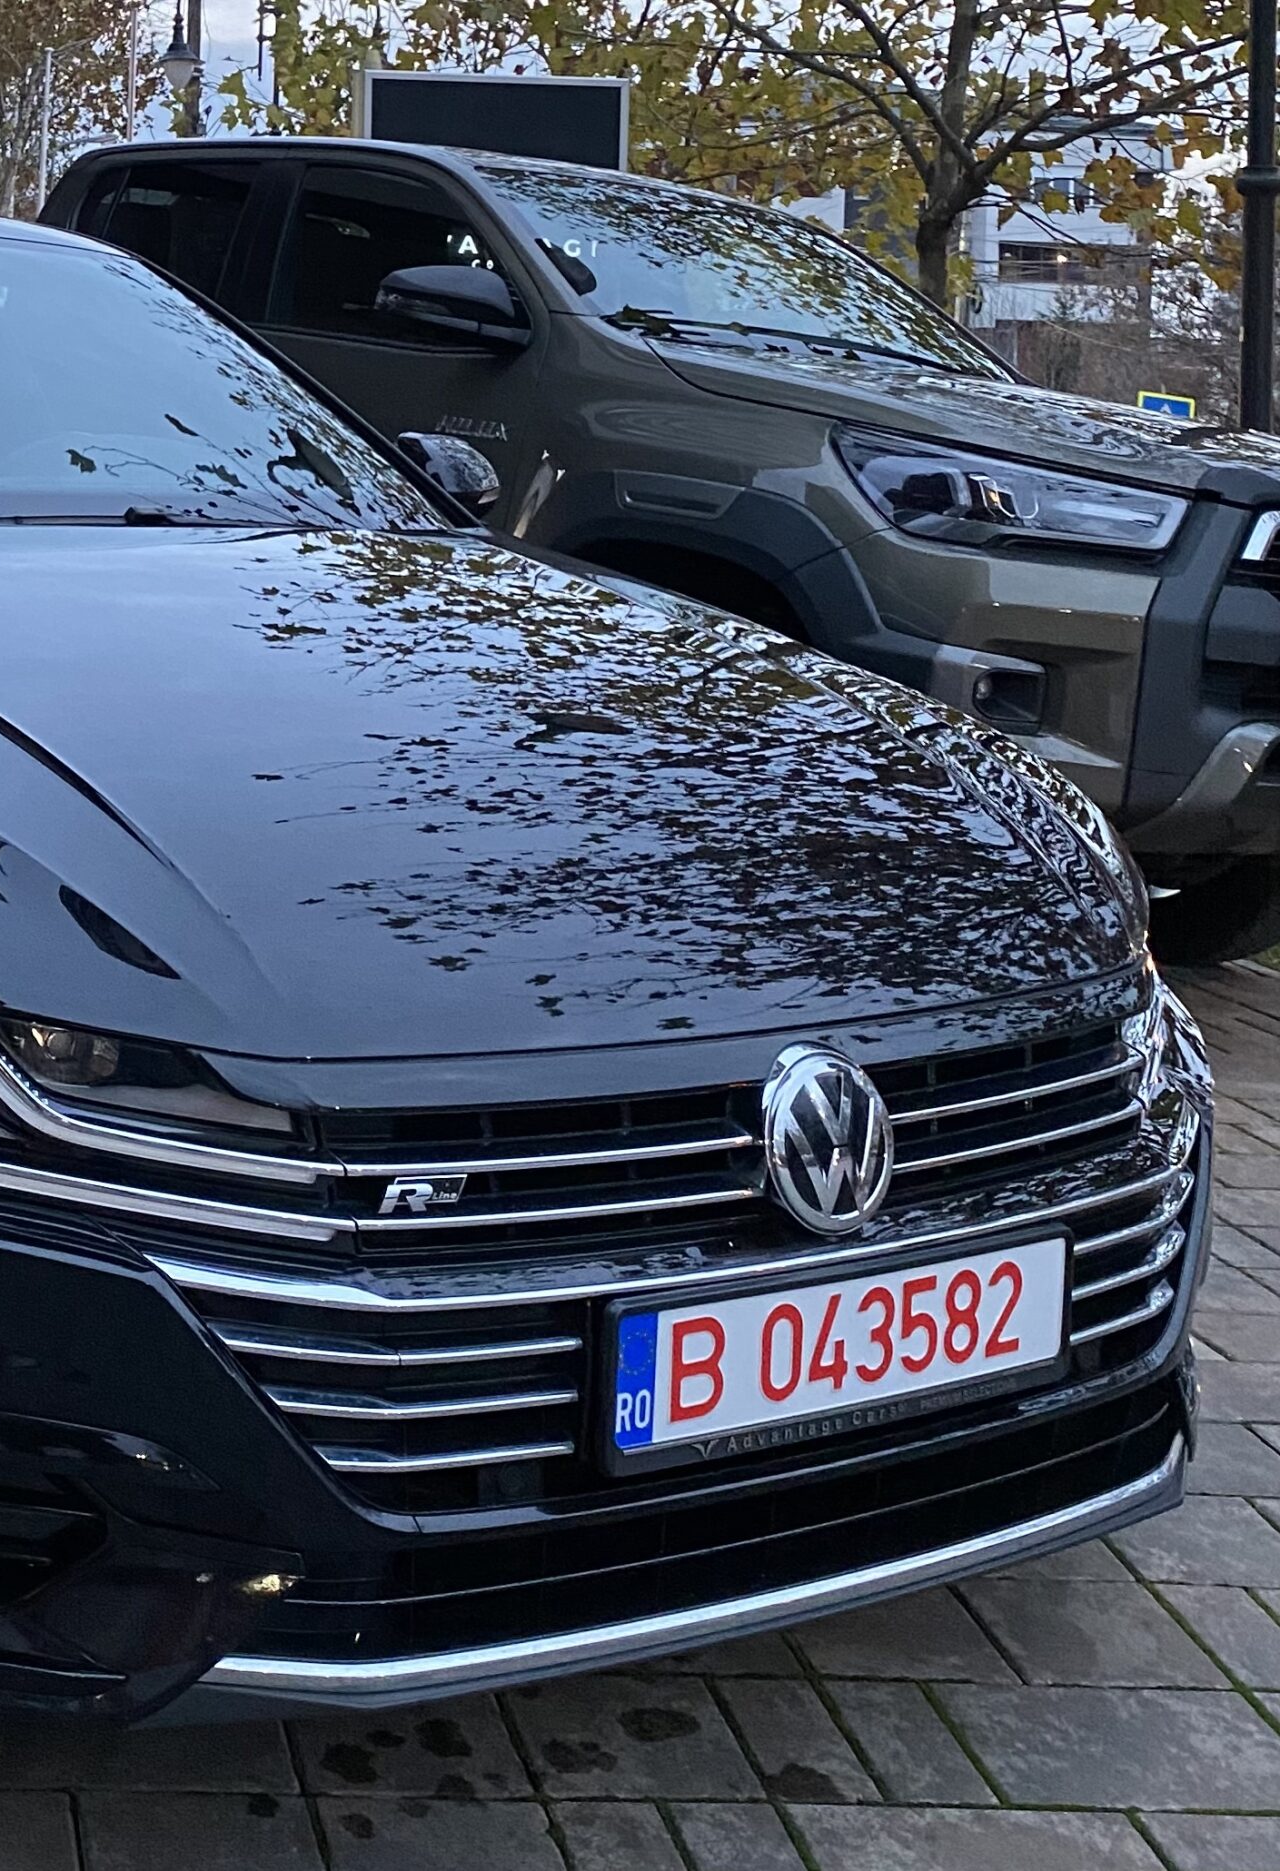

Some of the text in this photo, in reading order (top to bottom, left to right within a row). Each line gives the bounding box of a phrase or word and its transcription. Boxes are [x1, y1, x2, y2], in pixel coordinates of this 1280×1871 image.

[378, 1183, 433, 1214] R
[669, 1260, 1023, 1424] B 043582
[614, 1388, 651, 1434] RO
[726, 1416, 844, 1453] Advantage
